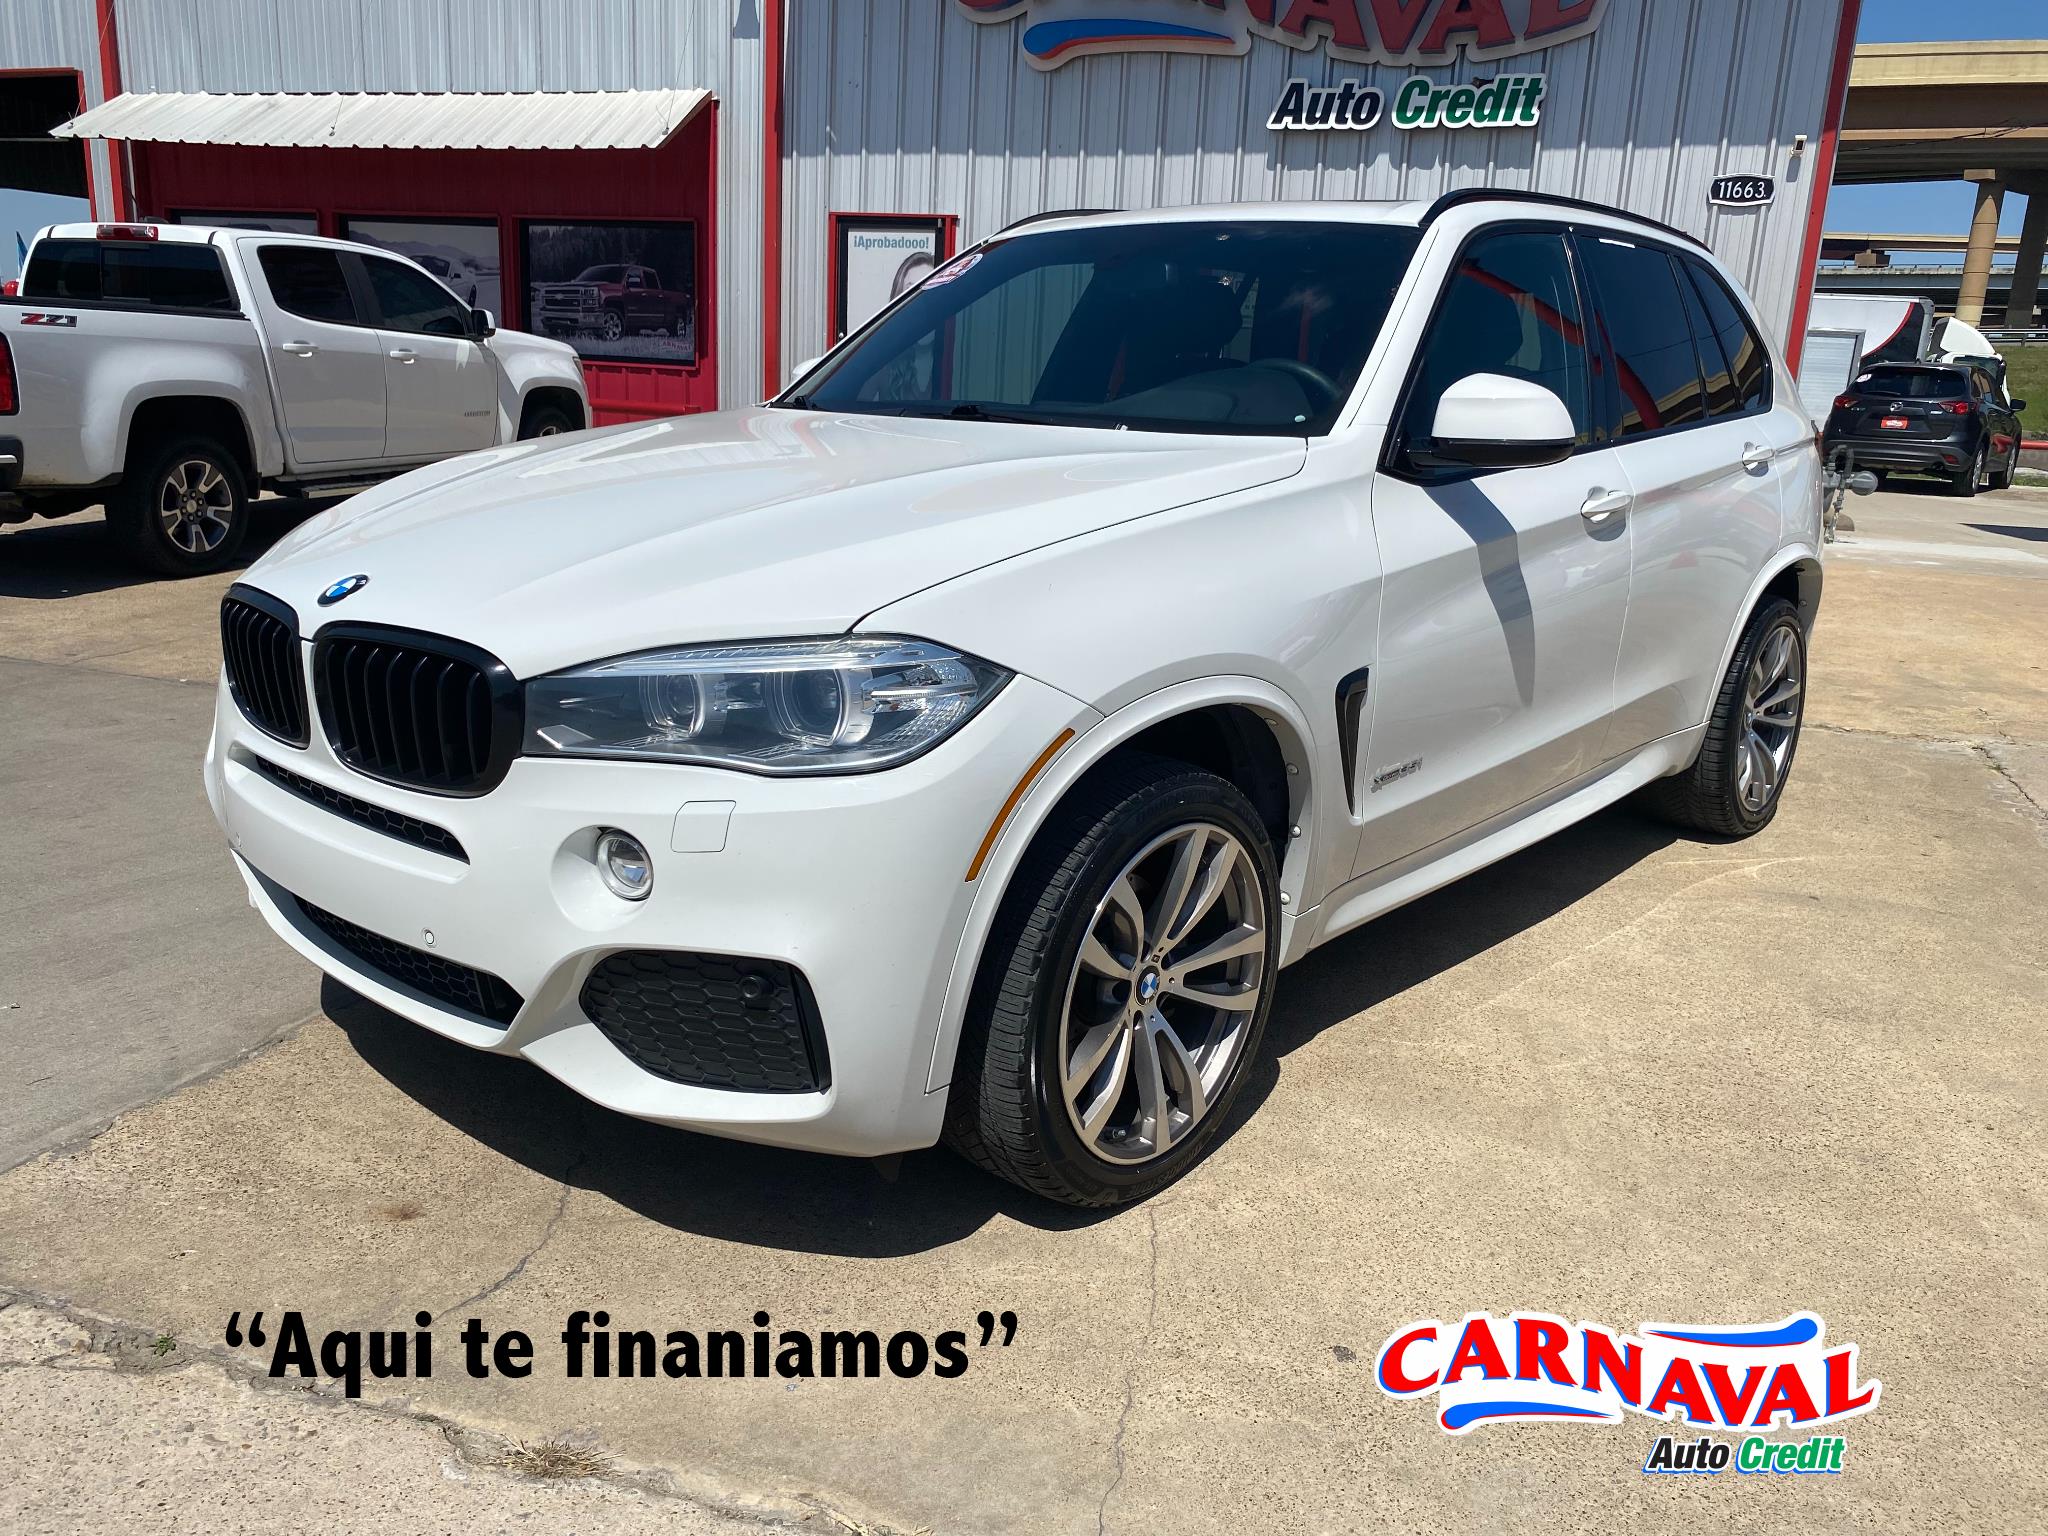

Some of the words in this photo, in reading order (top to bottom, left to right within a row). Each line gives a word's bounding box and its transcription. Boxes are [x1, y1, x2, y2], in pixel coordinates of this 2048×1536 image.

[1270, 81, 1383, 127] Auto
[1394, 76, 1543, 126] Credit
[1717, 181, 1766, 198] 11663
[20, 312, 78, 328] Z71
